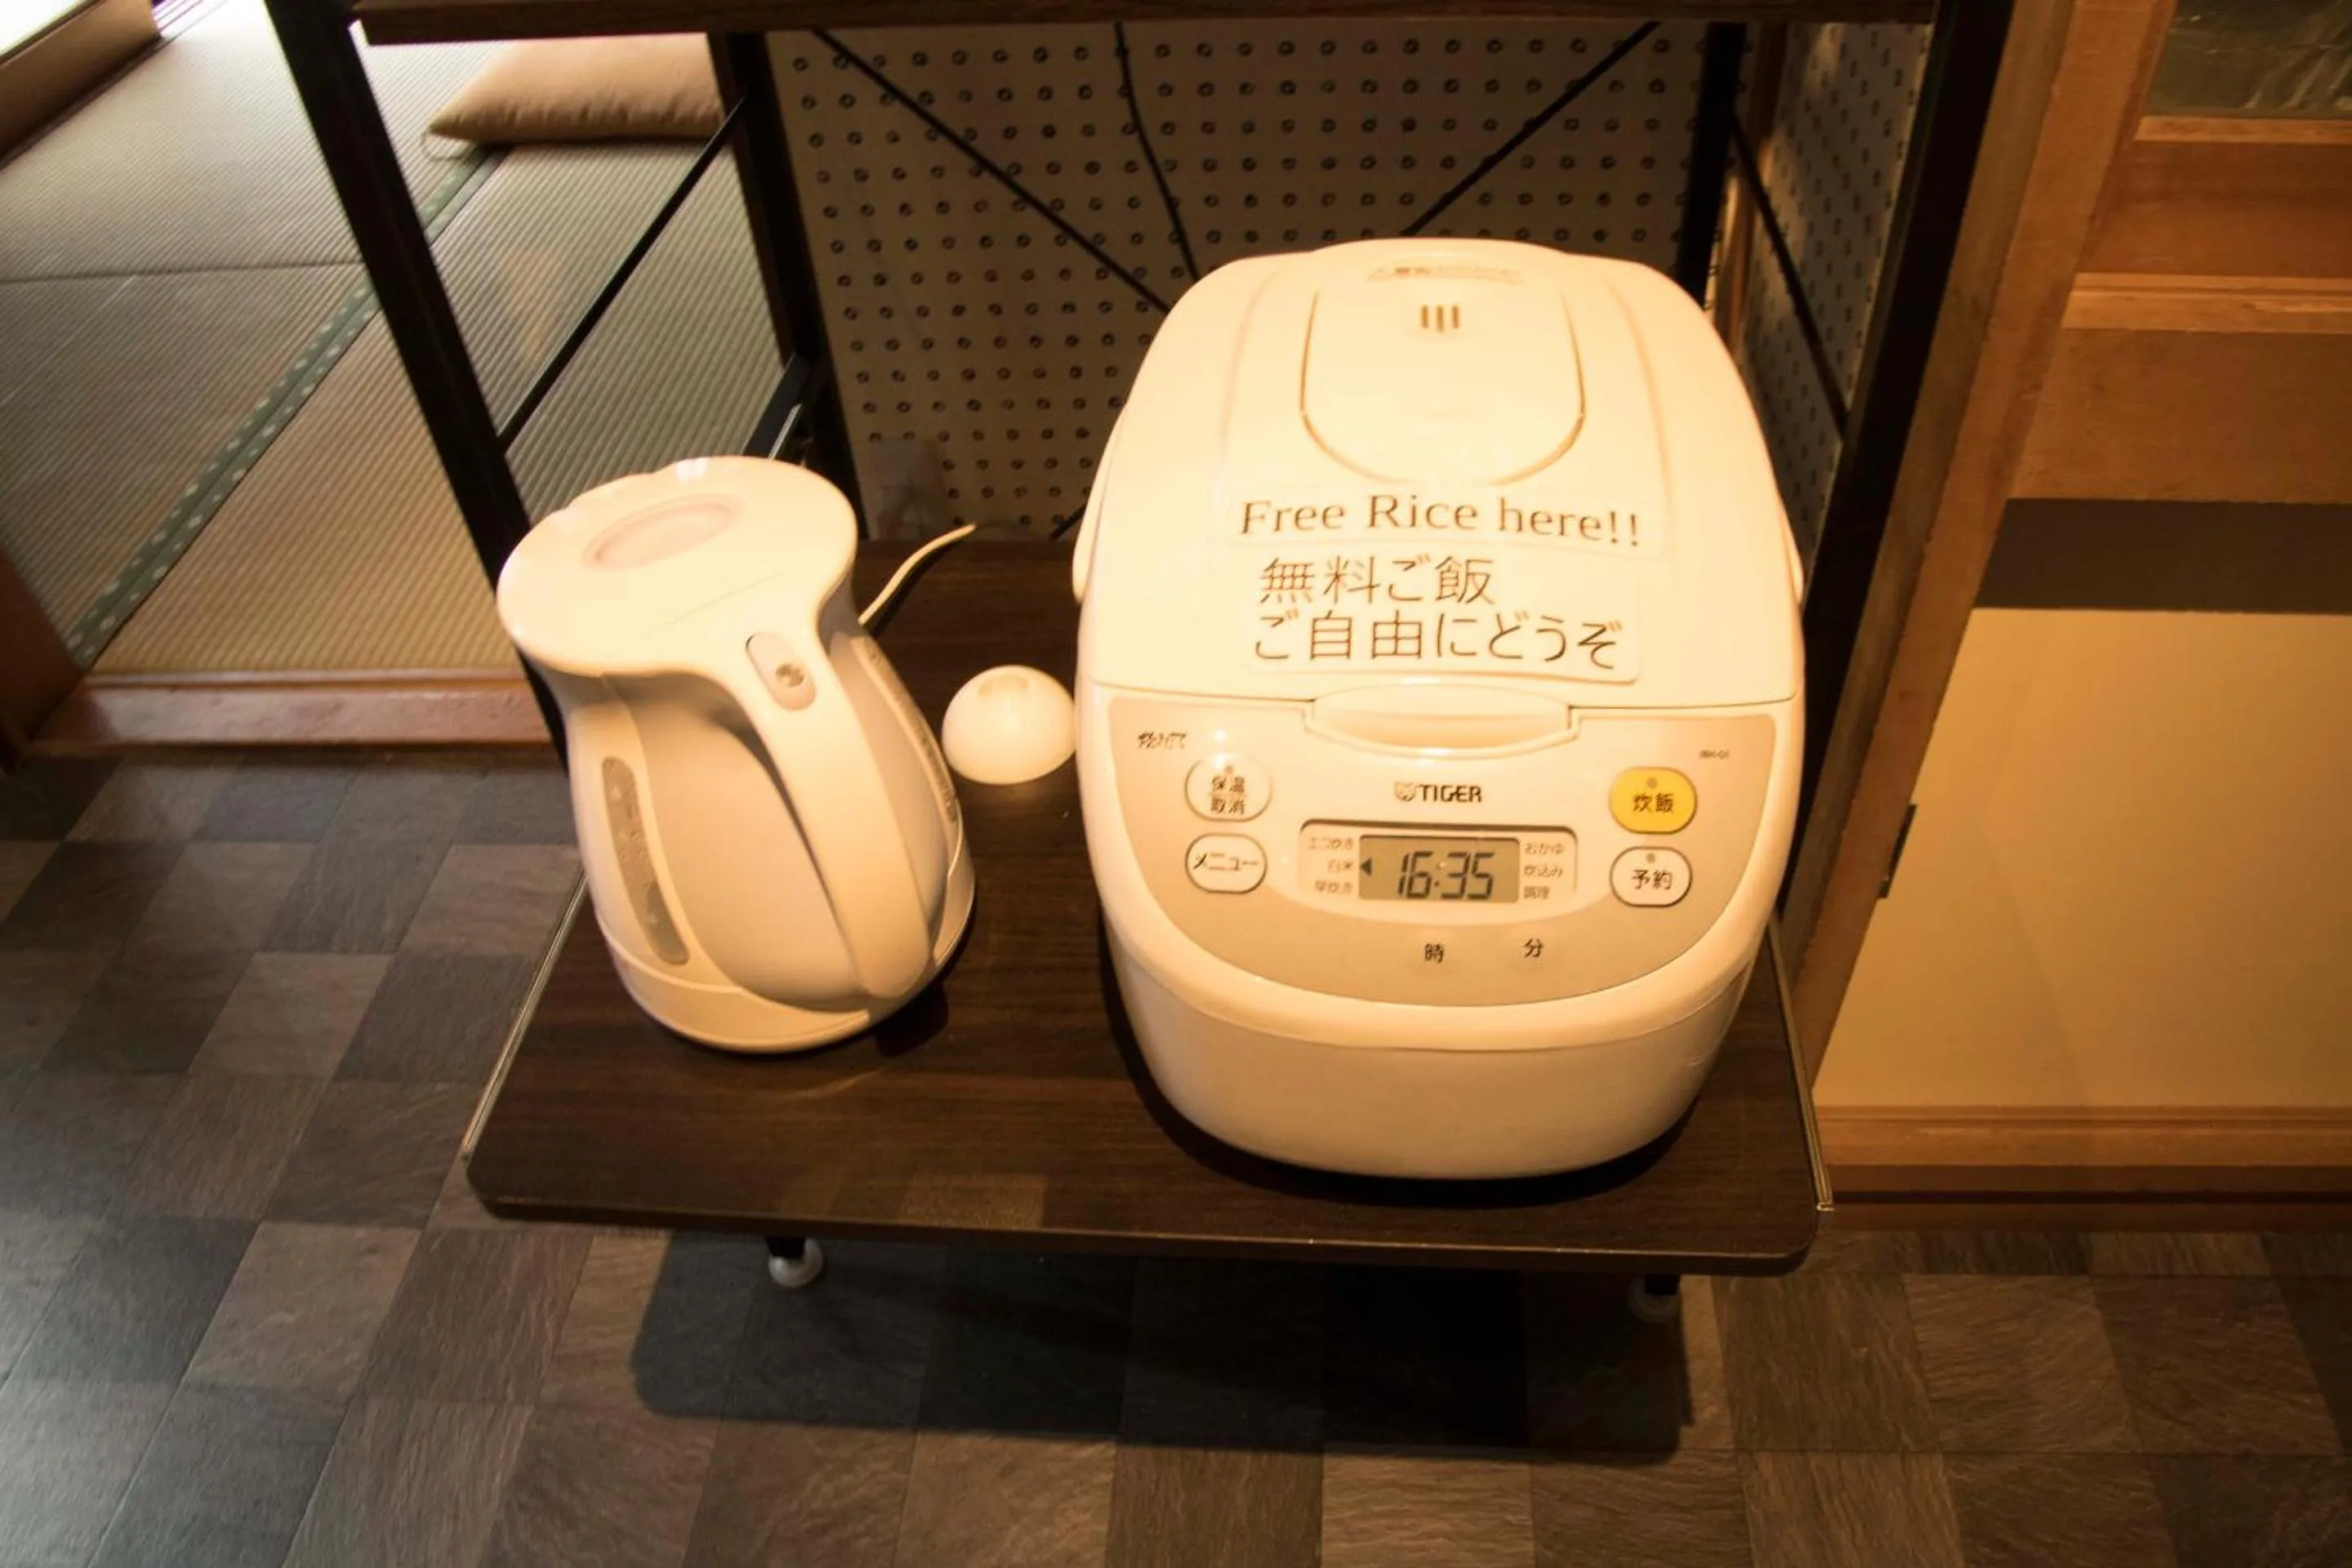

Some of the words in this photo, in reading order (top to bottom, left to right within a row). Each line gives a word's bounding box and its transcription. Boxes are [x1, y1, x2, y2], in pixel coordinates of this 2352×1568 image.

[1240, 500, 1346, 535] Free
[1367, 494, 1478, 530] Rice
[1498, 497, 1639, 547] here!!
[1259, 553, 1495, 605] 無料ご飯
[1254, 608, 1624, 670] ご自由にどうぞ
[1417, 783, 1482, 803] TIGER
[1633, 792, 1674, 814] 炊飯
[1192, 852, 1259, 871] メニュー
[1397, 850, 1495, 900] 16:35
[1631, 868, 1673, 890] 予約
[1523, 938, 1544, 958] 分
